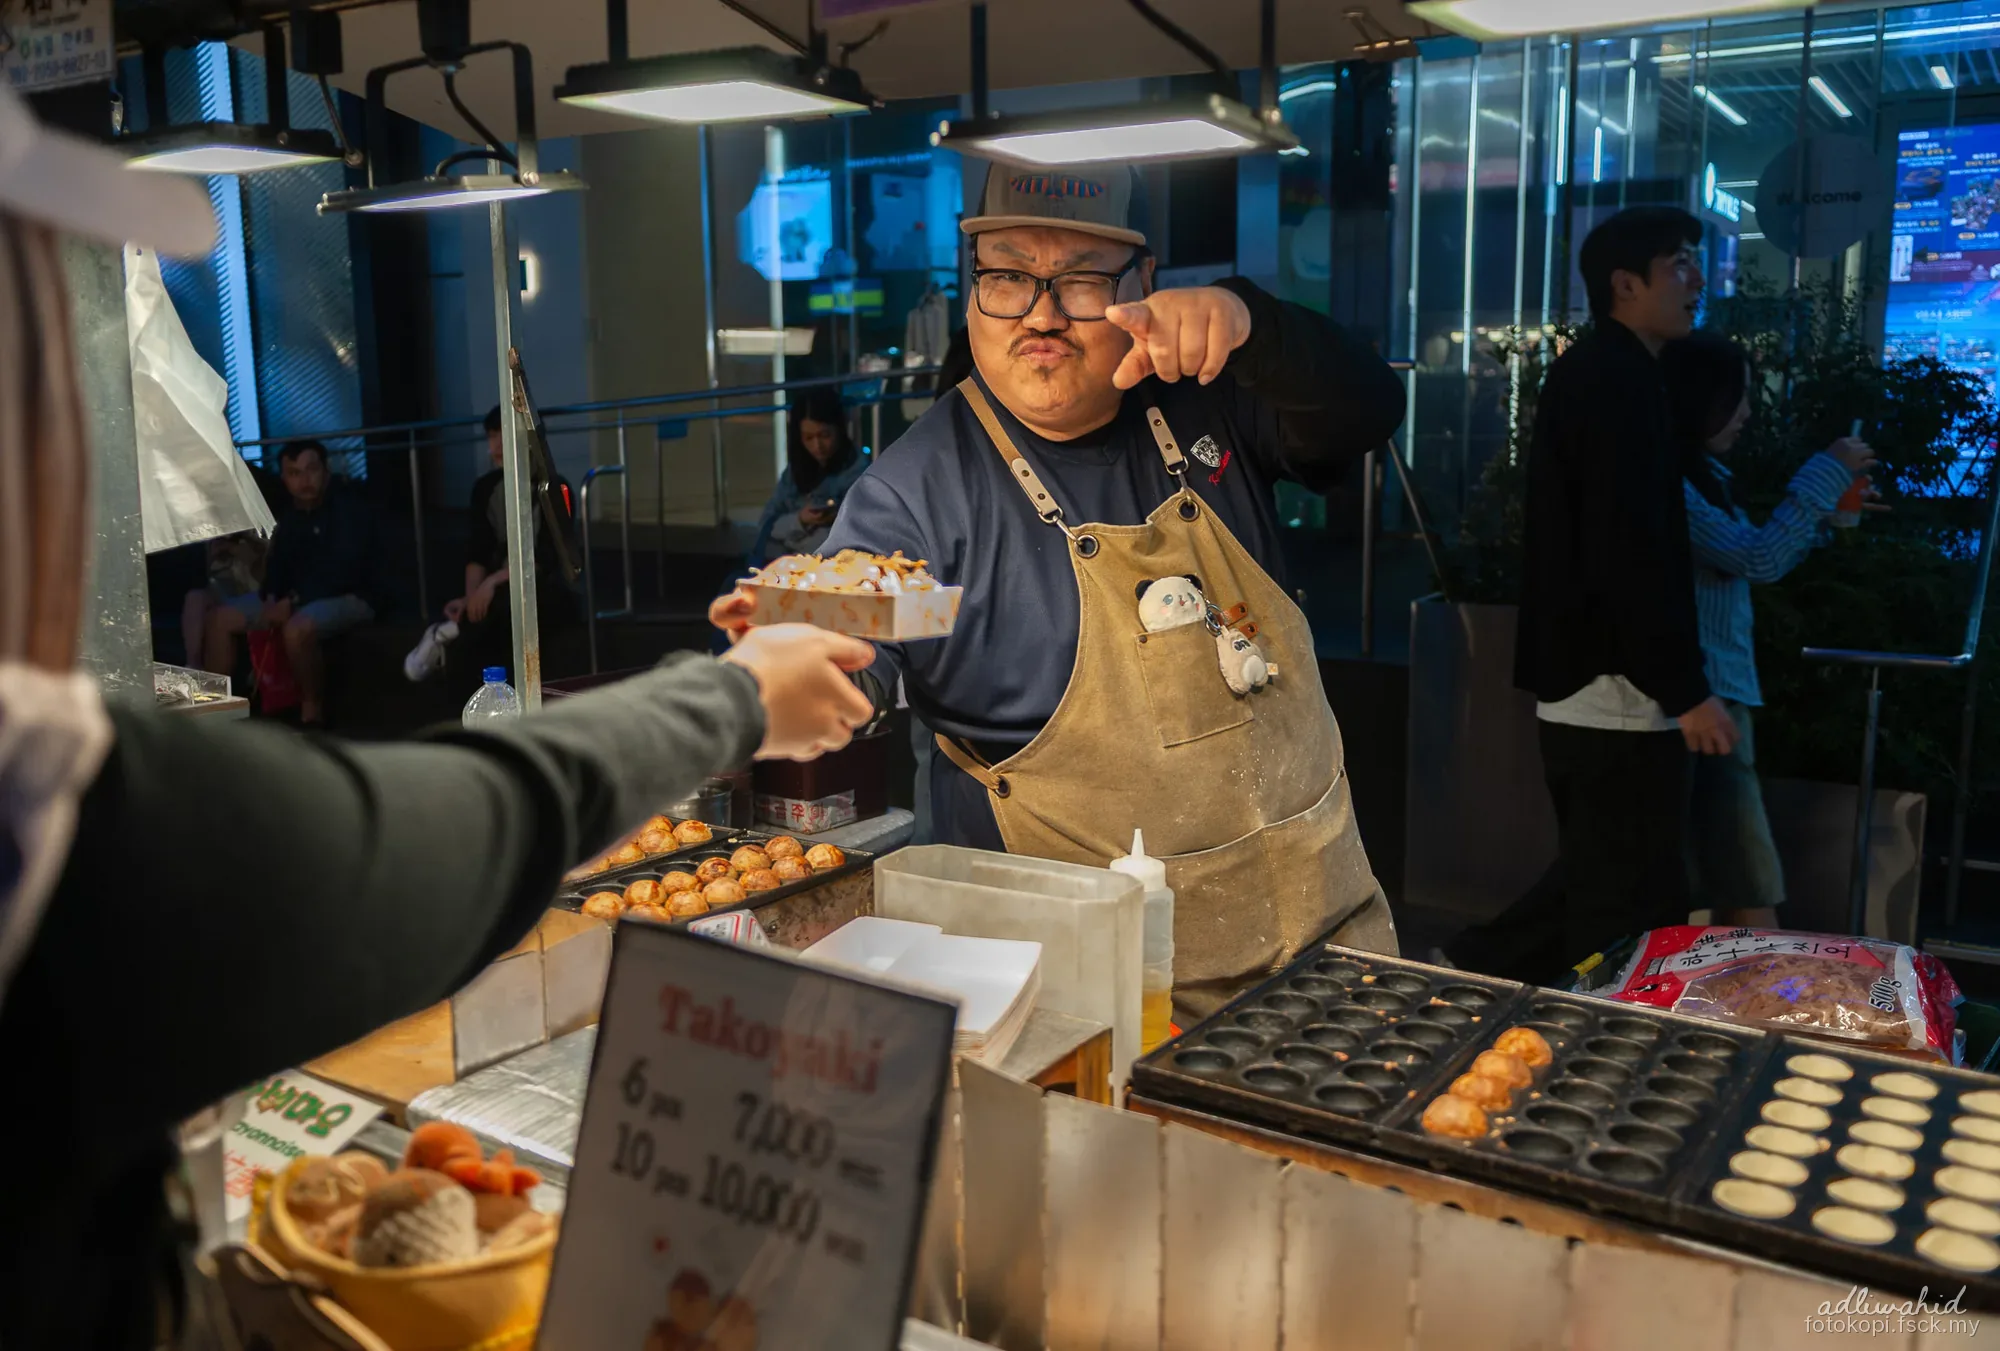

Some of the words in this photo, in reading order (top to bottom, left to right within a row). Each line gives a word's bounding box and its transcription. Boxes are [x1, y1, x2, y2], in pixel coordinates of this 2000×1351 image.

[658, 984, 886, 1095] Takoyaki
[1869, 976, 1902, 1012] 500g
[620, 1057, 651, 1107] 6
[734, 1093, 836, 1167] 7,000
[609, 1121, 655, 1181] 10
[699, 1153, 823, 1244] 10,000
